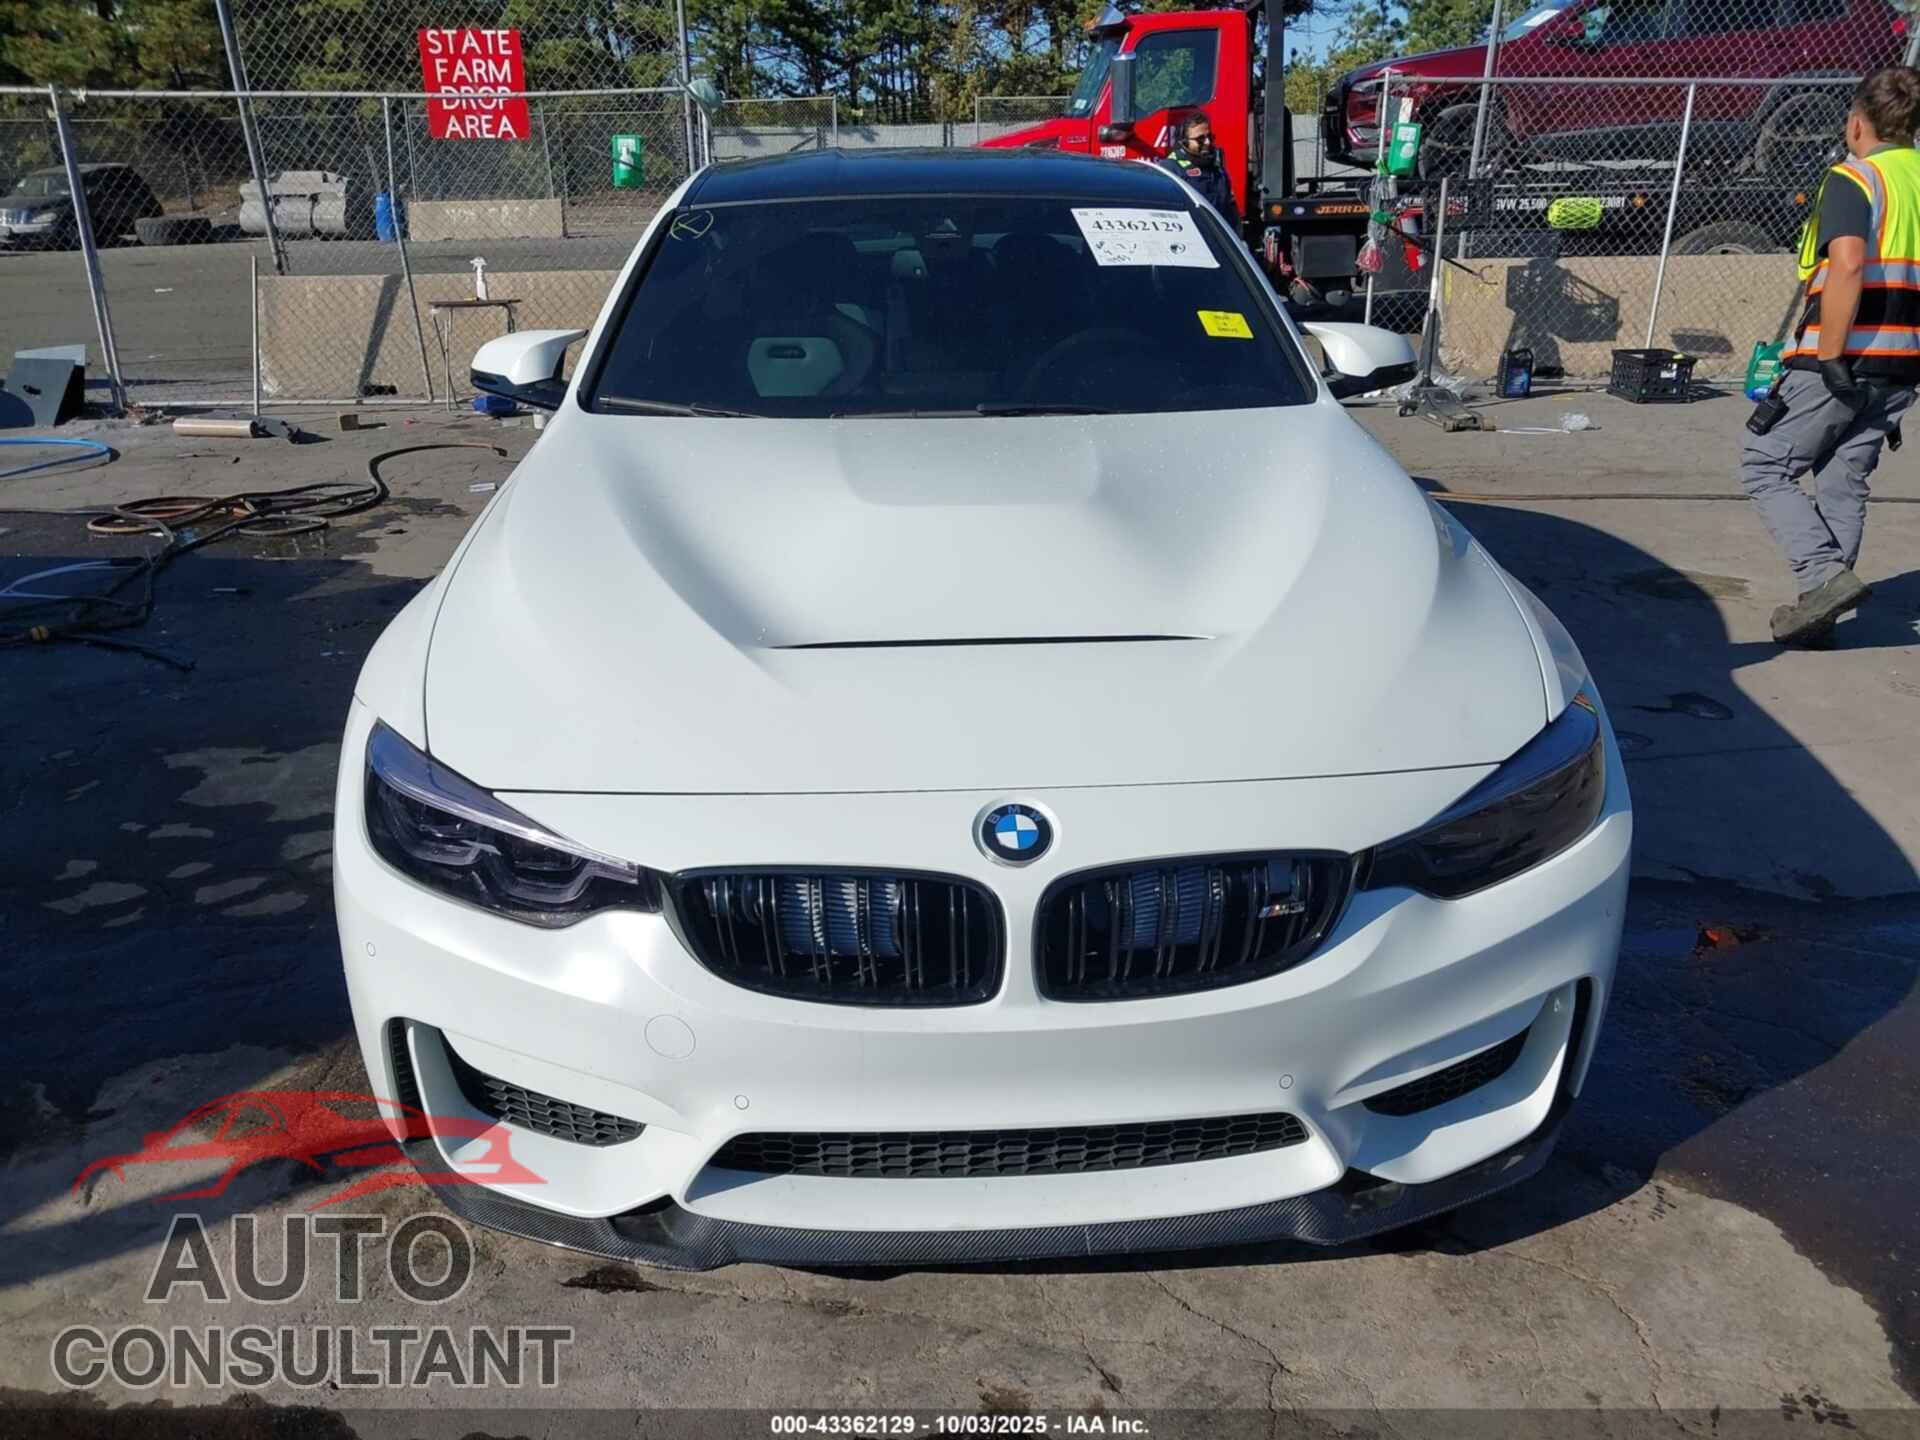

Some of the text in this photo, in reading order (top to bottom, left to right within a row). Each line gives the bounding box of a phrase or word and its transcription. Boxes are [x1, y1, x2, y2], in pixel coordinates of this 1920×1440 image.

[426, 29, 513, 55] STATE
[435, 58, 512, 83] FARM
[441, 85, 512, 110] DROP
[445, 115, 517, 139] AREA
[1092, 220, 1184, 233] 43362129
[987, 804, 1043, 824] BMW
